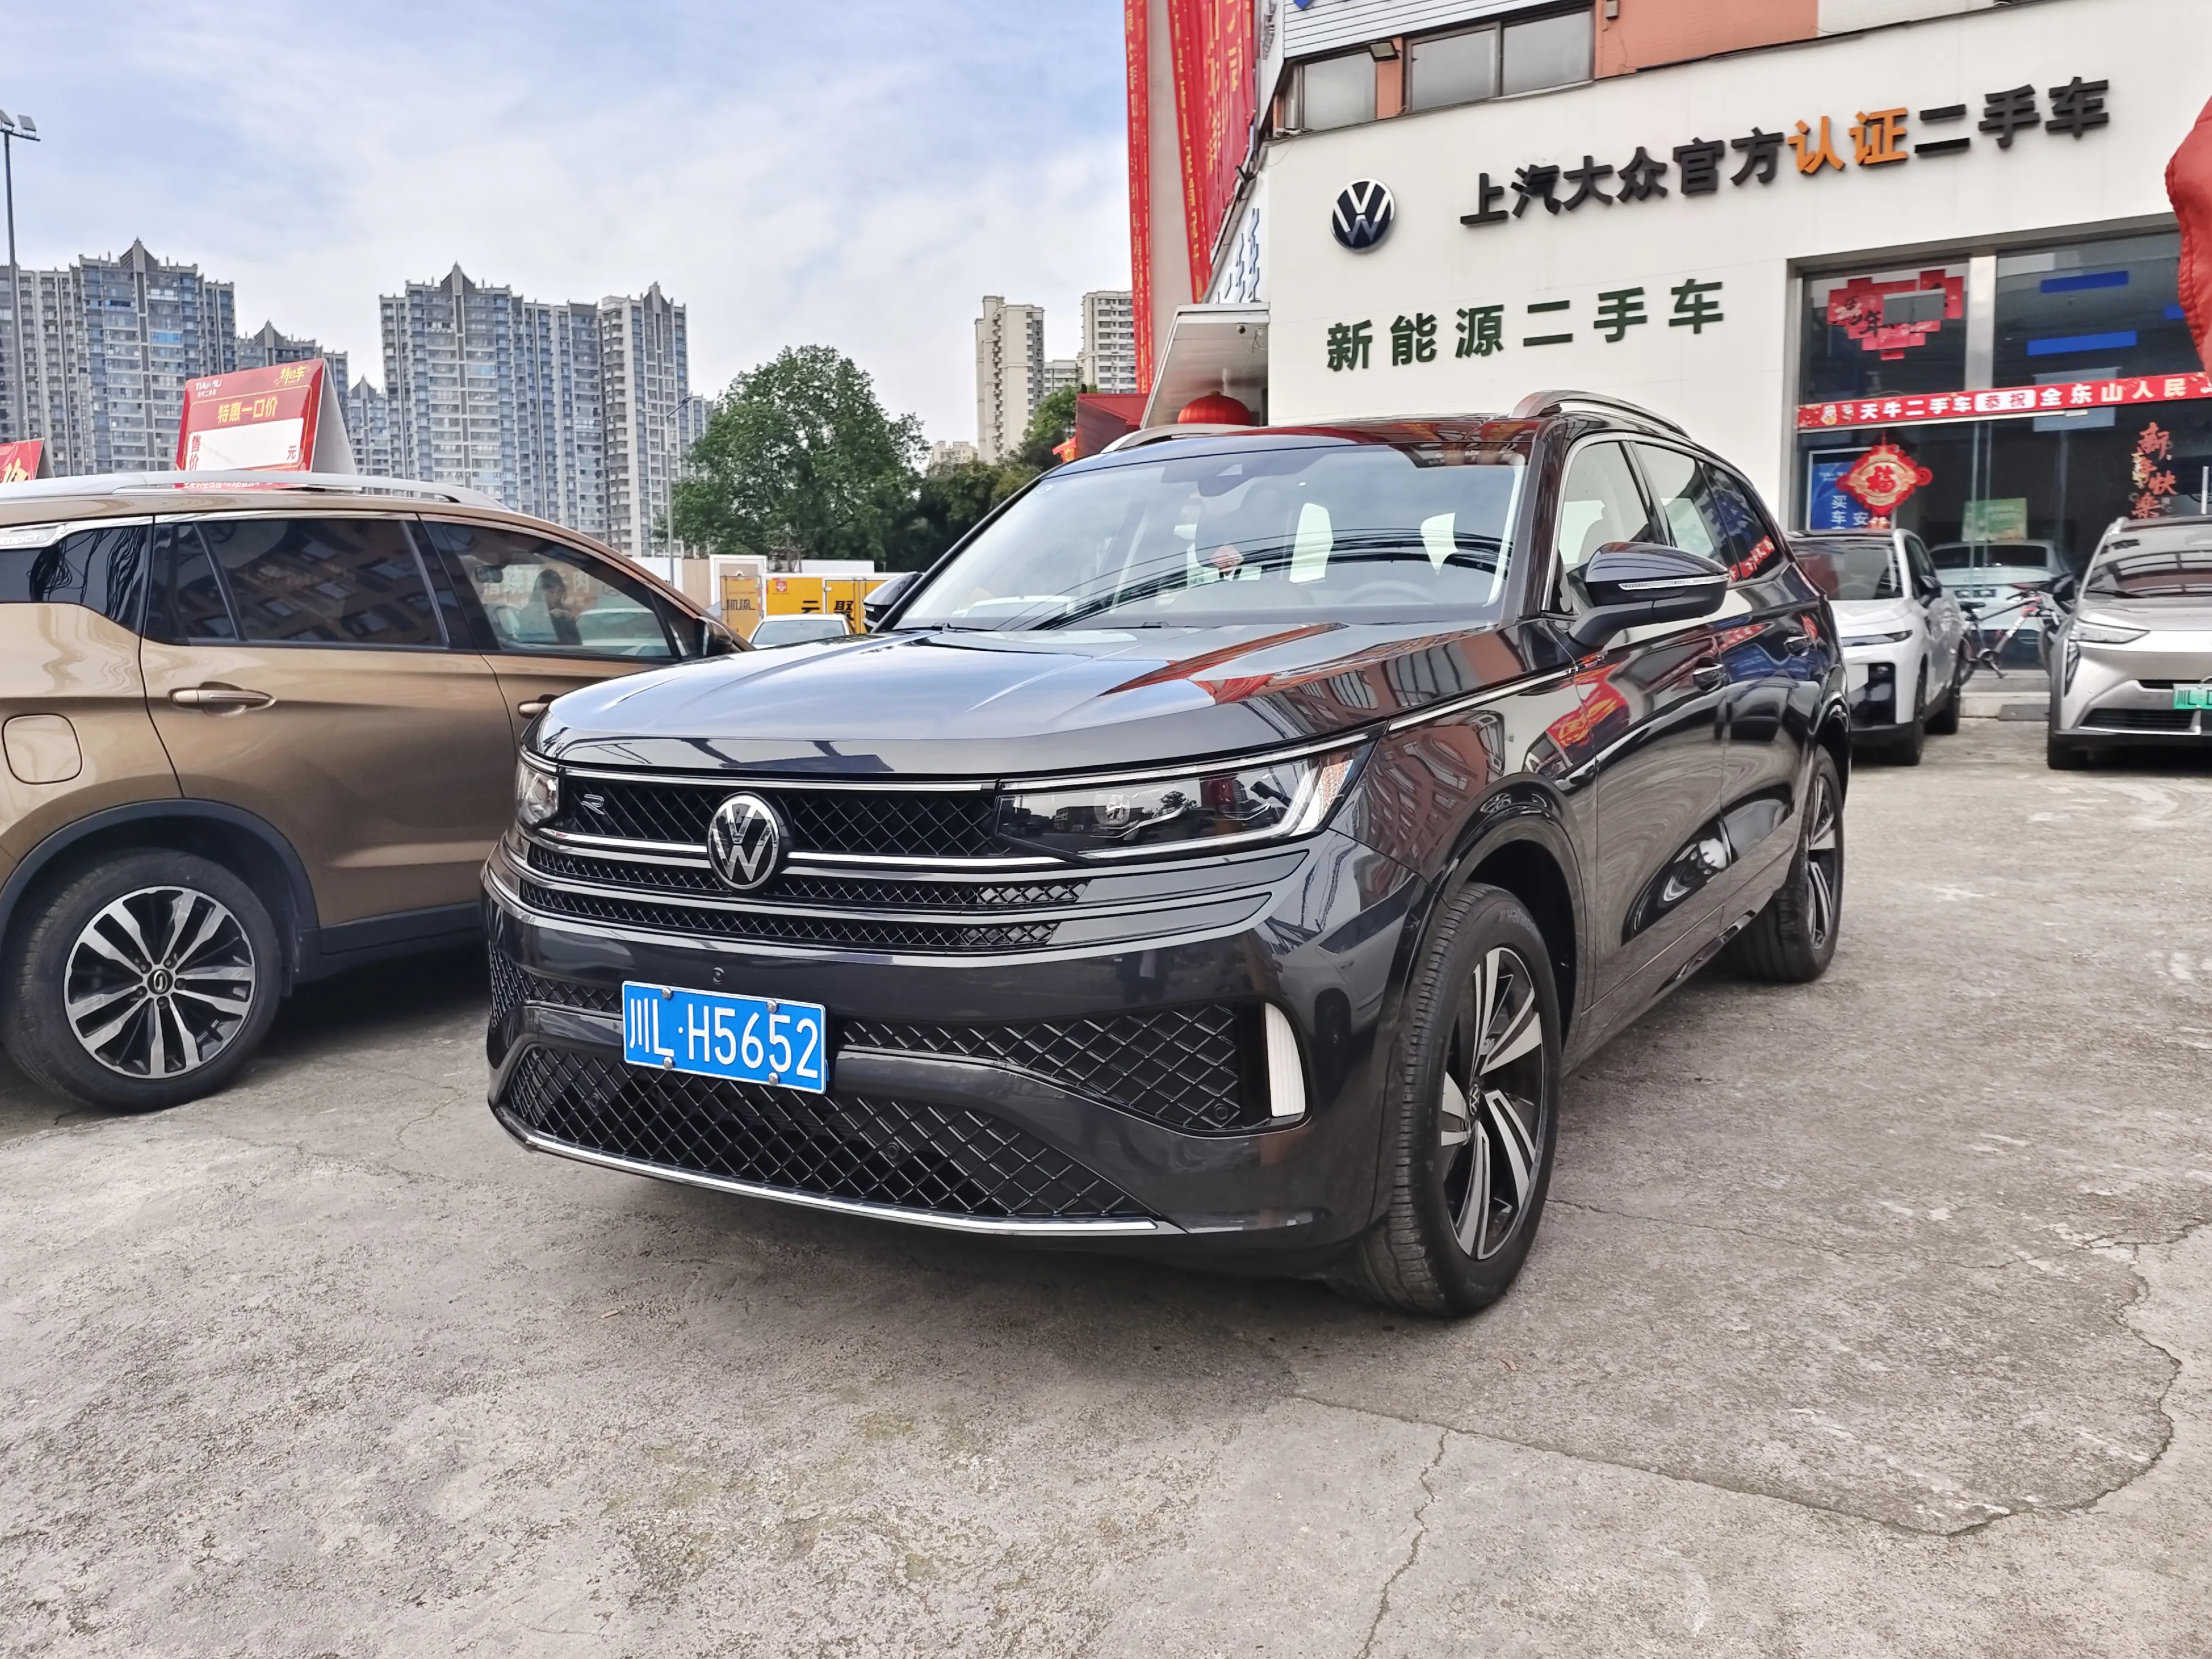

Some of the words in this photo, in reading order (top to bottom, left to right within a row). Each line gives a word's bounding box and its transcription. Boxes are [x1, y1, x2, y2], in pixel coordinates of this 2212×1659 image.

[1460, 76, 2109, 225] 上汽大众官方认证二手车
[1326, 278, 1724, 373] 新能源二手车
[218, 396, 278, 423] 特惠一口价
[287, 445, 296, 460] 元
[1866, 465, 1896, 493] 福
[1830, 495, 1848, 529] 买车
[630, 997, 819, 1079] 川L·H5652
